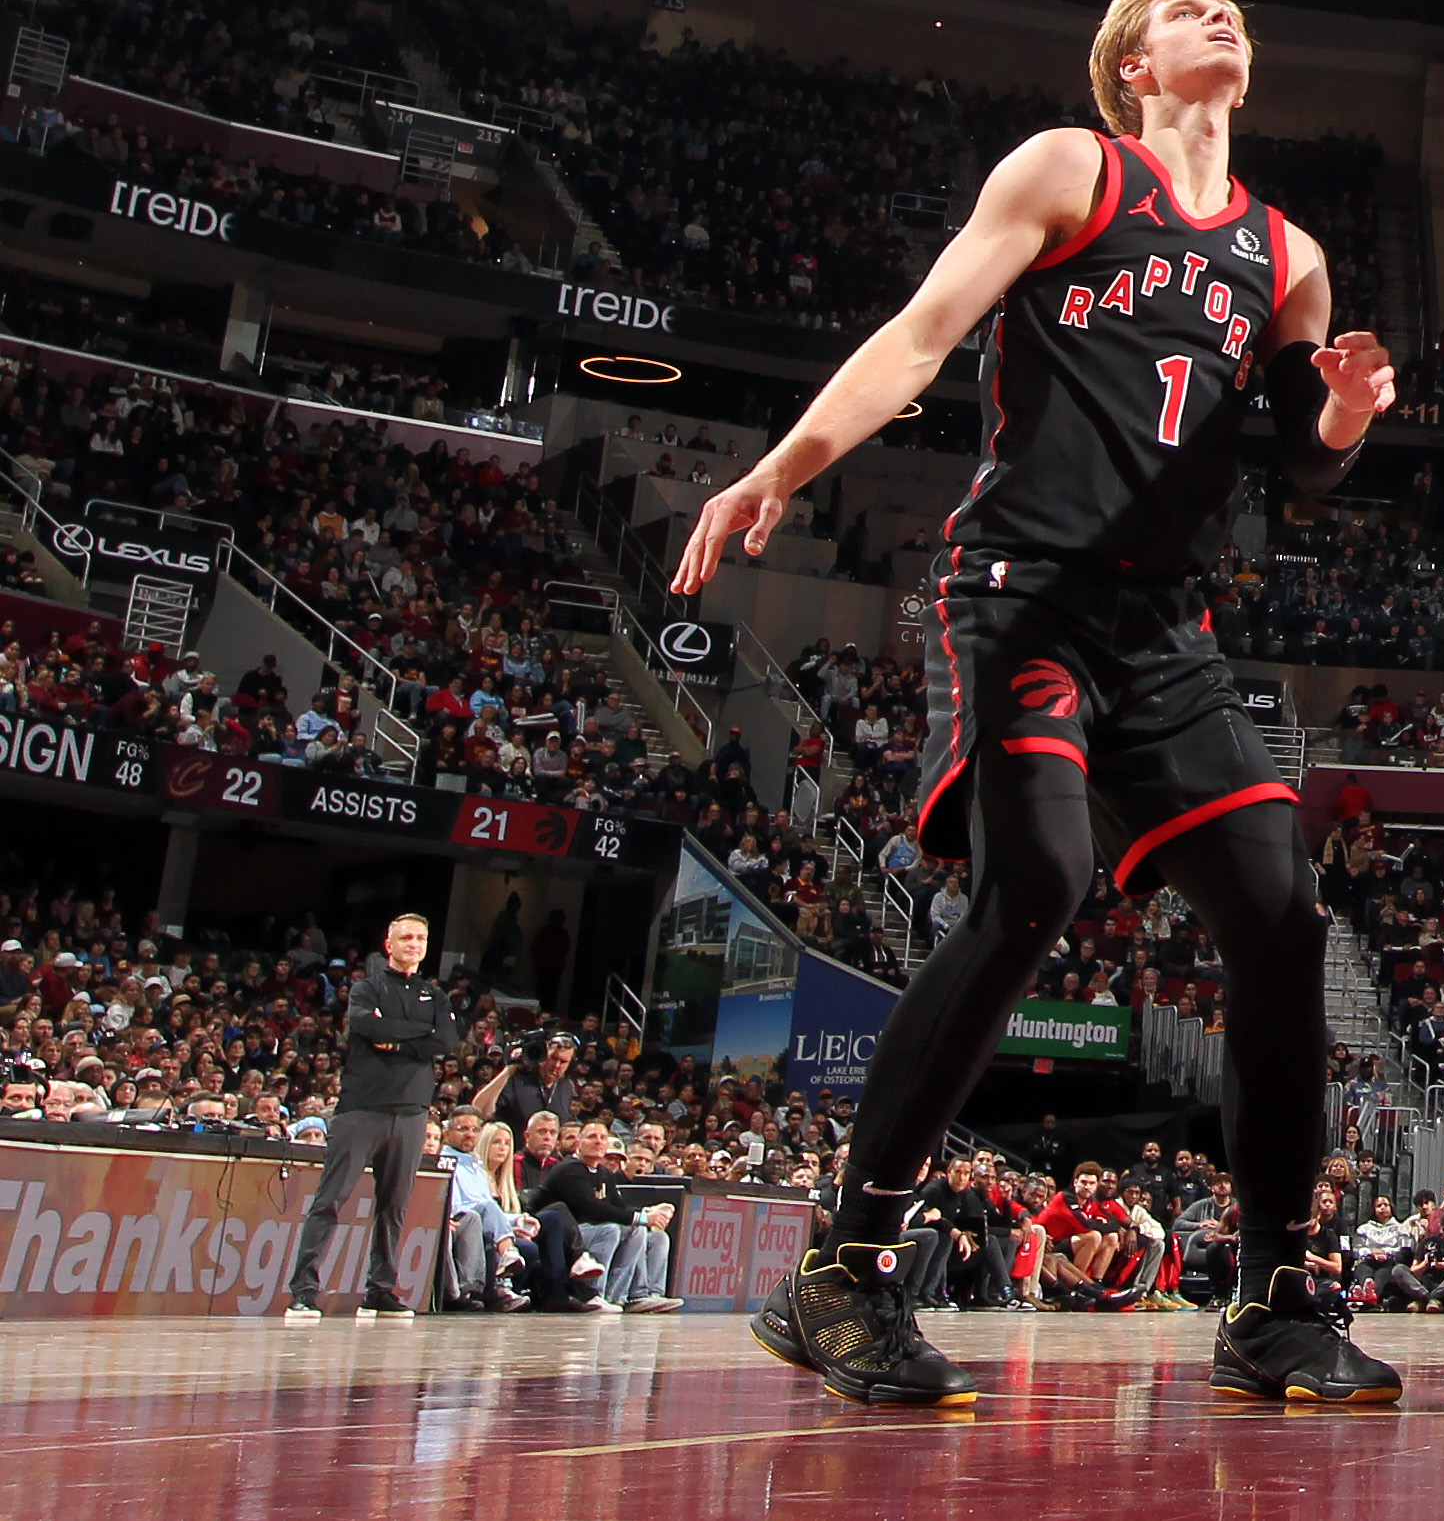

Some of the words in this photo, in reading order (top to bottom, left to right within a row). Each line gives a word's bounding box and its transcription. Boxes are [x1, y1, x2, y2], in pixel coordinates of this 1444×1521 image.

[1058, 250, 1256, 391] RAPTORS
[1155, 355, 1195, 446] 1
[97, 537, 212, 574] LEXUS
[116, 739, 150, 760] FG%
[115, 760, 143, 787] 48
[222, 766, 262, 806] 22
[311, 785, 418, 824] ASSISTS
[470, 806, 509, 843] 21
[594, 817, 628, 836] FG%
[594, 835, 621, 859] 42
[1007, 1012, 1118, 1049] Huntington
[810, 1075, 822, 1085] OF
[823, 1075, 868, 1086] OSTEOPAT
[690, 1220, 735, 1264] drug
[758, 1223, 797, 1265] drug
[688, 1263, 739, 1297] mart
